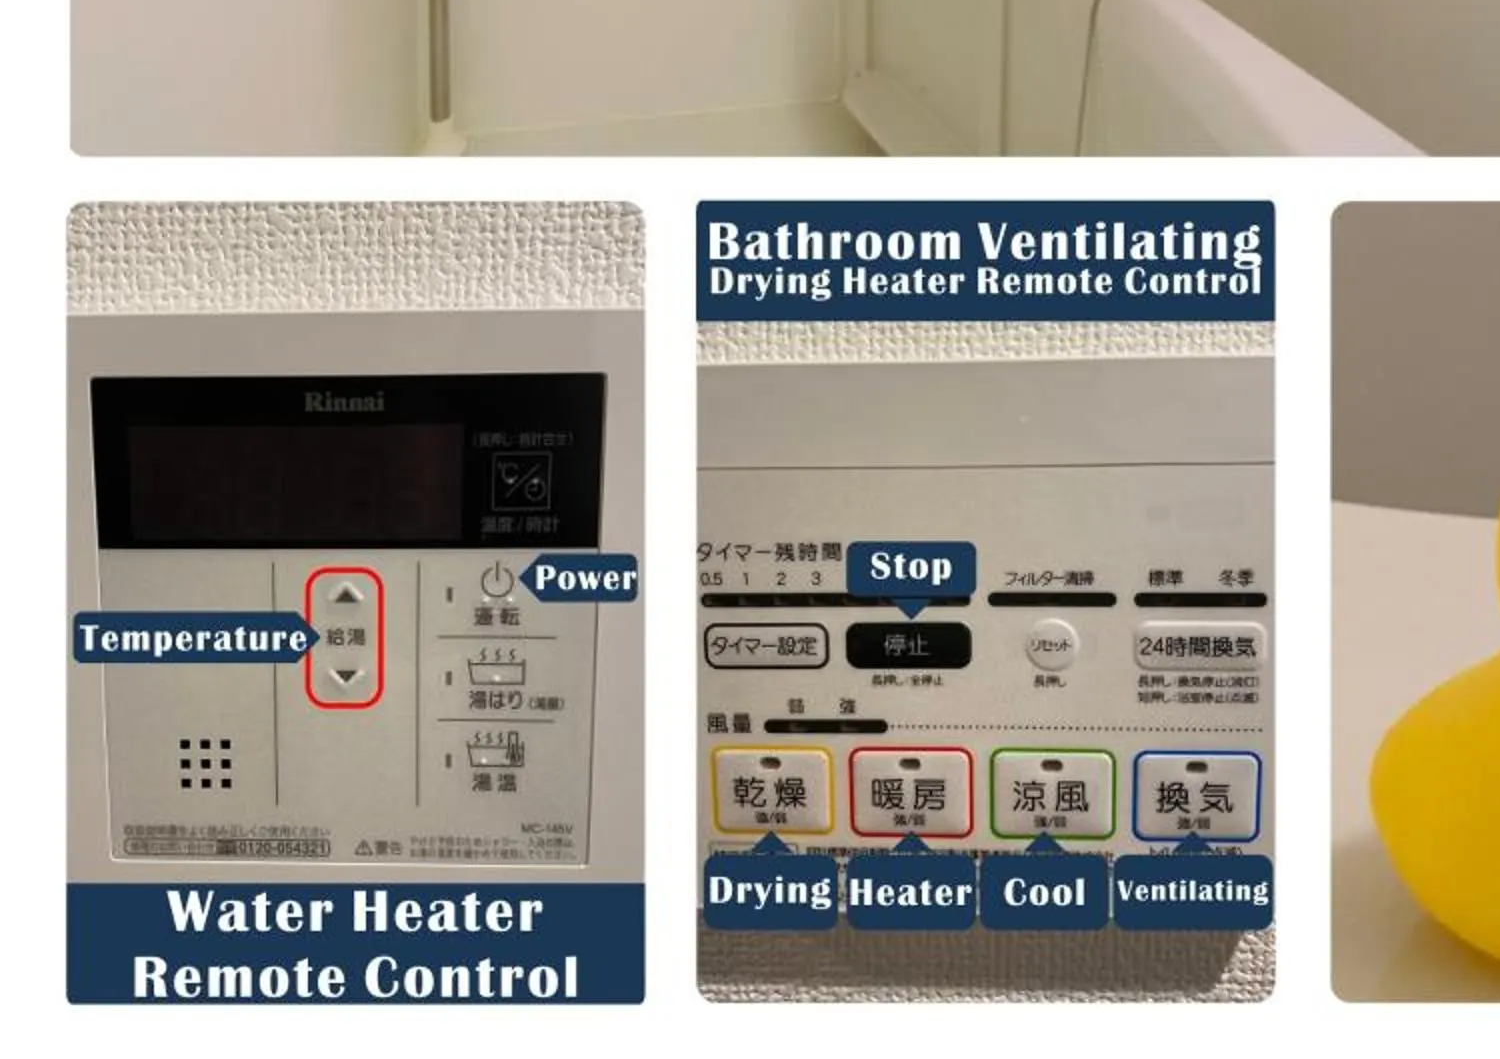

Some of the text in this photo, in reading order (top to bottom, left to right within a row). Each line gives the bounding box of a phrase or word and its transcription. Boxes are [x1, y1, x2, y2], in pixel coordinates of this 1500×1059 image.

[304, 392, 386, 413] Rinnai
[697, 542, 843, 562] タイマー残時間
[701, 572, 822, 586] 0.5 1 2 3
[1004, 571, 1095, 587] フィルター清掃
[1149, 570, 1254, 588] 標準 冬季
[474, 607, 521, 627] 運転
[326, 628, 366, 646] 給湯
[711, 636, 818, 657] タイマー設定
[884, 634, 931, 657] 停止
[1030, 639, 1071, 653] リセット
[1139, 637, 1256, 658] 24時間換気
[1033, 674, 1067, 688] 長押し
[469, 691, 523, 710] 湯はり
[839, 698, 857, 714] 強
[707, 712, 752, 733] 風量
[472, 773, 517, 792] 湯温
[734, 777, 807, 808] 乾燥
[871, 778, 946, 811] 暖房
[1012, 780, 1090, 813] 涼風
[1155, 781, 1234, 814] 換気
